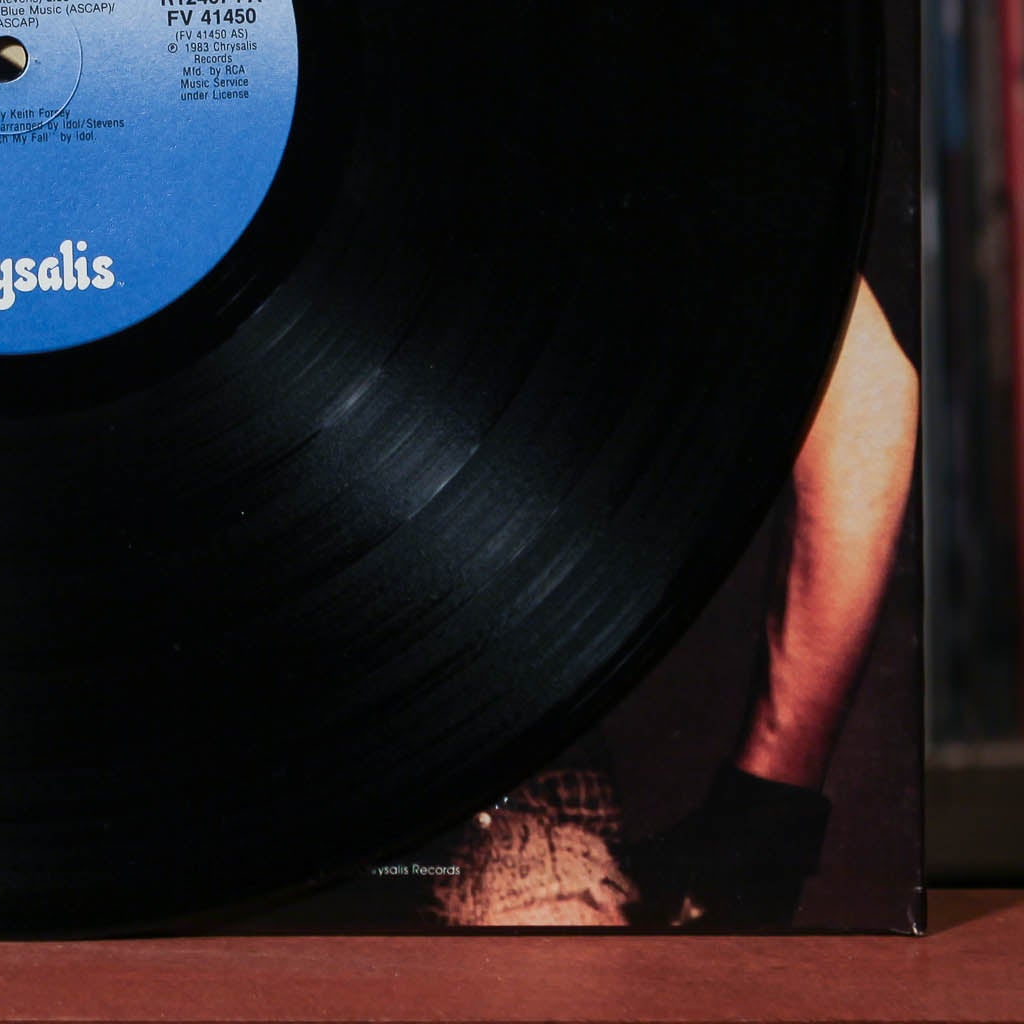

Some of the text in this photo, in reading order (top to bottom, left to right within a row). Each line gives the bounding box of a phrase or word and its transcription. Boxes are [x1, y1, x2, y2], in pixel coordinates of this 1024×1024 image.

[0, 6, 25, 16] Blue
[29, 5, 62, 15] Music
[65, 2, 115, 16] (ASCAP)/
[167, 8, 257, 26] FV 41450
[175, 28, 248, 42] (FV 41450 AS)
[185, 42, 209, 53] 1983
[213, 40, 257, 53] Chrysalis
[194, 53, 233, 64] Records
[183, 65, 246, 77] Mfd. by RCA
[181, 77, 249, 89] Music Service
[180, 89, 249, 101] under License
[10, 108, 35, 119] Keith
[38, 108, 71, 119] Forsey
[47, 120, 58, 131] by
[63, 118, 125, 129] Idol/Stevens
[13, 133, 27, 145] My
[60, 131, 72, 143] by
[76, 131, 97, 142] Idol.
[412, 863, 461, 876] Records
